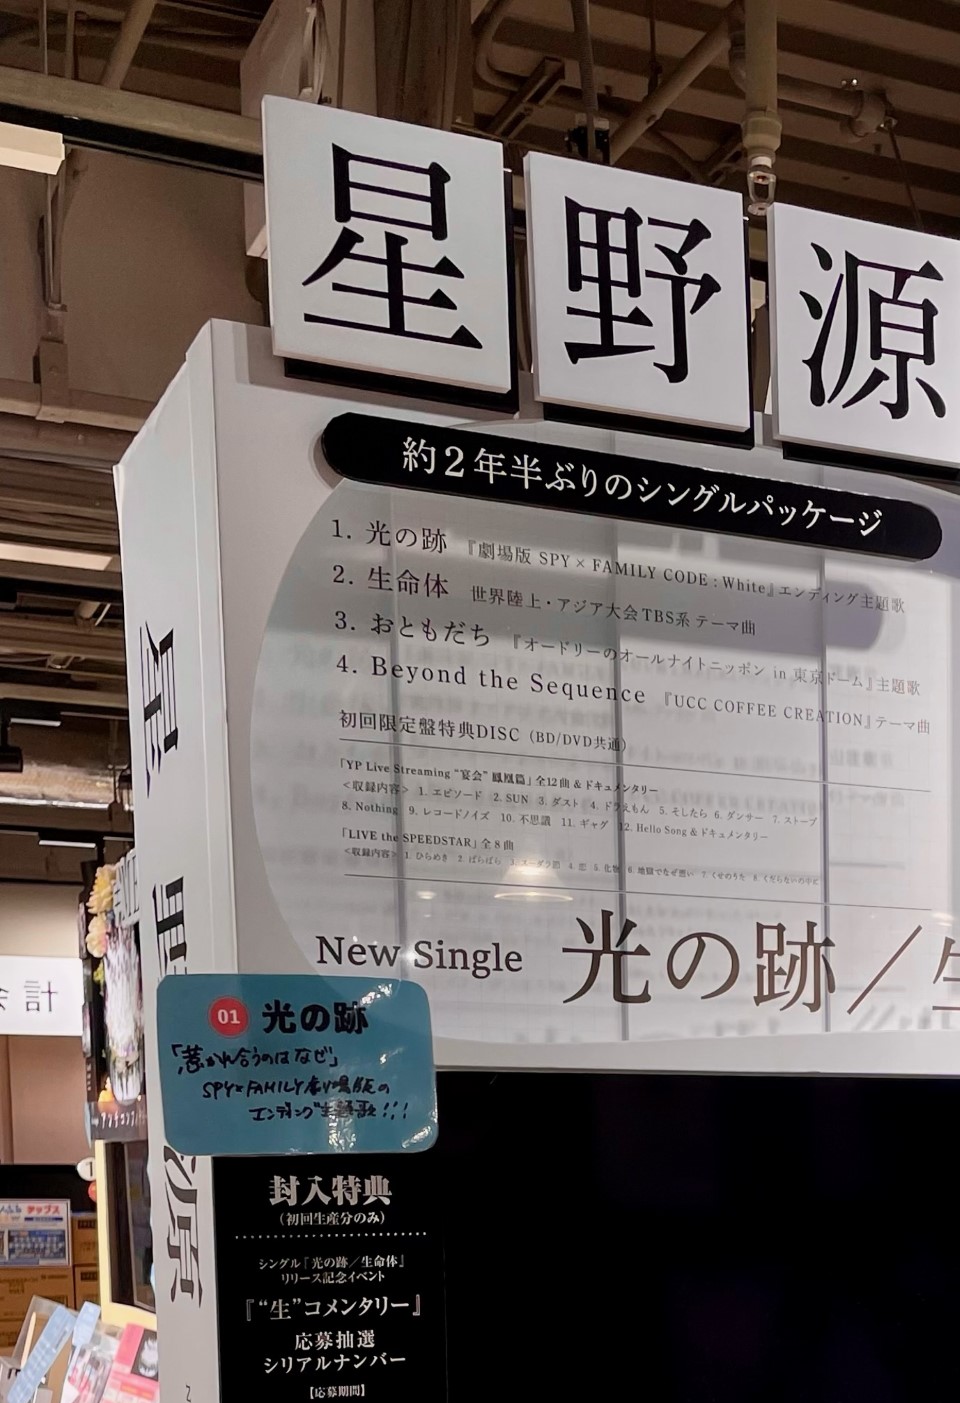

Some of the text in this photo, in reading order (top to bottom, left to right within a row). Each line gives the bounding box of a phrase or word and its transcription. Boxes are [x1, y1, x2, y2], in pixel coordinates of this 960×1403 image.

[301, 142, 946, 421] 星野源
[402, 435, 882, 538] 約2年半ぶりのシングルパッケージ
[331, 519, 351, 539] 1.
[366, 521, 447, 553] 光の跡
[468, 540, 531, 565] 『劇場版
[539, 551, 571, 568] SPY
[593, 558, 656, 580] FAMILY
[664, 569, 708, 587] CODE
[333, 565, 354, 585] 2.
[368, 566, 449, 599] 生命体
[335, 611, 356, 631] 3.
[371, 612, 490, 647] おともだち
[773, 666, 787, 680] in
[336, 655, 357, 674] 4.
[372, 656, 466, 684] Beyond
[479, 669, 518, 690] the
[530, 672, 646, 704] Sequence
[714, 697, 777, 718] COFFEE
[339, 709, 520, 743] 初回限定盤特典DISC
[366, 762, 391, 773] Live
[393, 764, 450, 780] Streaming
[506, 793, 529, 805] SUN
[355, 802, 399, 816] Nothing
[636, 823, 661, 835] Hello
[665, 825, 687, 838] Song
[381, 830, 398, 843] the
[315, 935, 524, 980] New Single
[217, 999, 369, 1035] 01 光の跡
[269, 1175, 393, 1206] 封入特典
[279, 1211, 386, 1227] (初回生産分のみ)
[281, 1270, 386, 1286] リリース記念イベント
[294, 1330, 375, 1351] 応募抽選
[263, 1352, 407, 1374] シリアルナンバー
